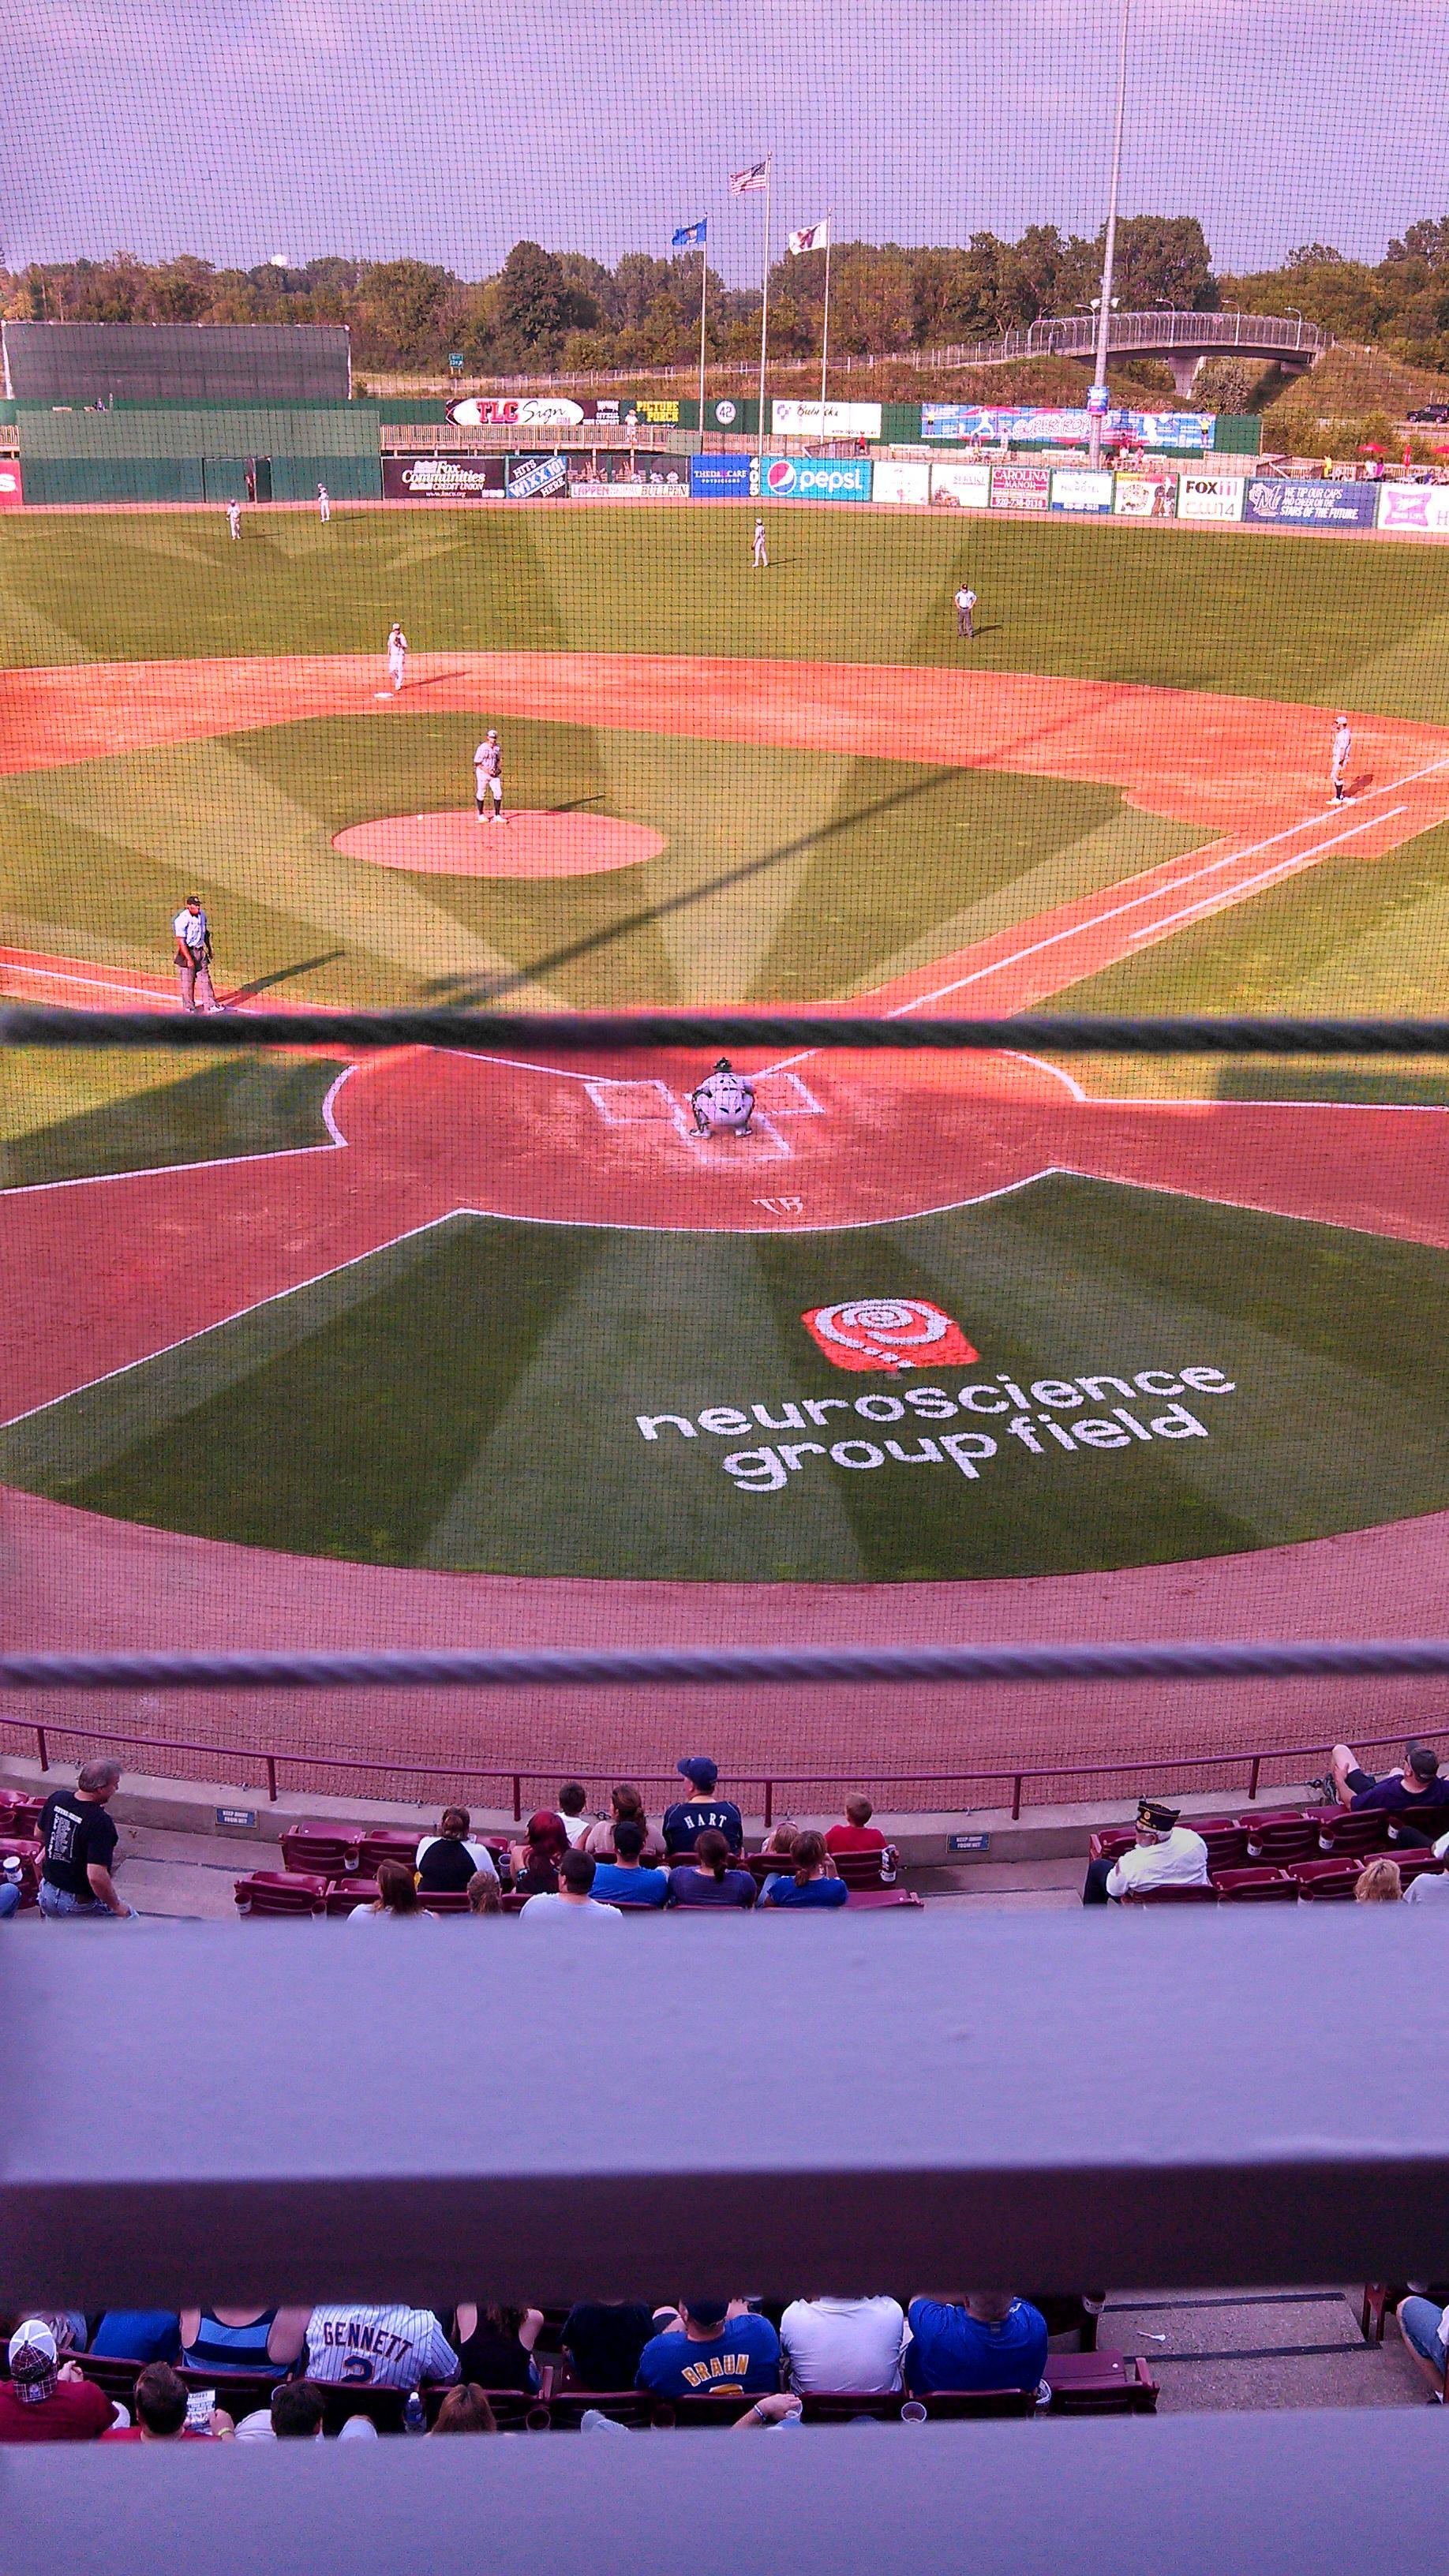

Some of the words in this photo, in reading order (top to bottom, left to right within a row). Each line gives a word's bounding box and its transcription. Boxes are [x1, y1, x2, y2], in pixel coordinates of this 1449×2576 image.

[477, 400, 519, 424] TLC
[522, 400, 566, 424] Sign
[635, 401, 679, 412] PICTURE
[719, 406, 732, 417] 42
[646, 411, 679, 422] PORCH
[436, 461, 461, 474] Fox
[512, 459, 537, 479] HITS
[994, 469, 1049, 482] CAROLINA
[402, 470, 486, 483] Communities
[509, 468, 549, 498] WIXX
[799, 468, 863, 492] pepsi
[540, 477, 566, 497] HERE
[641, 485, 687, 496] BULLPEN
[1005, 480, 1037, 490] MANOR
[1186, 480, 1218, 495] FOX
[1308, 488, 1324, 498] OUR
[1324, 489, 1343, 500] CAPS
[635, 1365, 1237, 1442] neuroscience
[721, 1431, 998, 1492] group
[1005, 1402, 1210, 1455] field
[683, 1812, 728, 1829] HART
[323, 2321, 415, 2363] GENNETT
[680, 2353, 750, 2387] BRAUN
